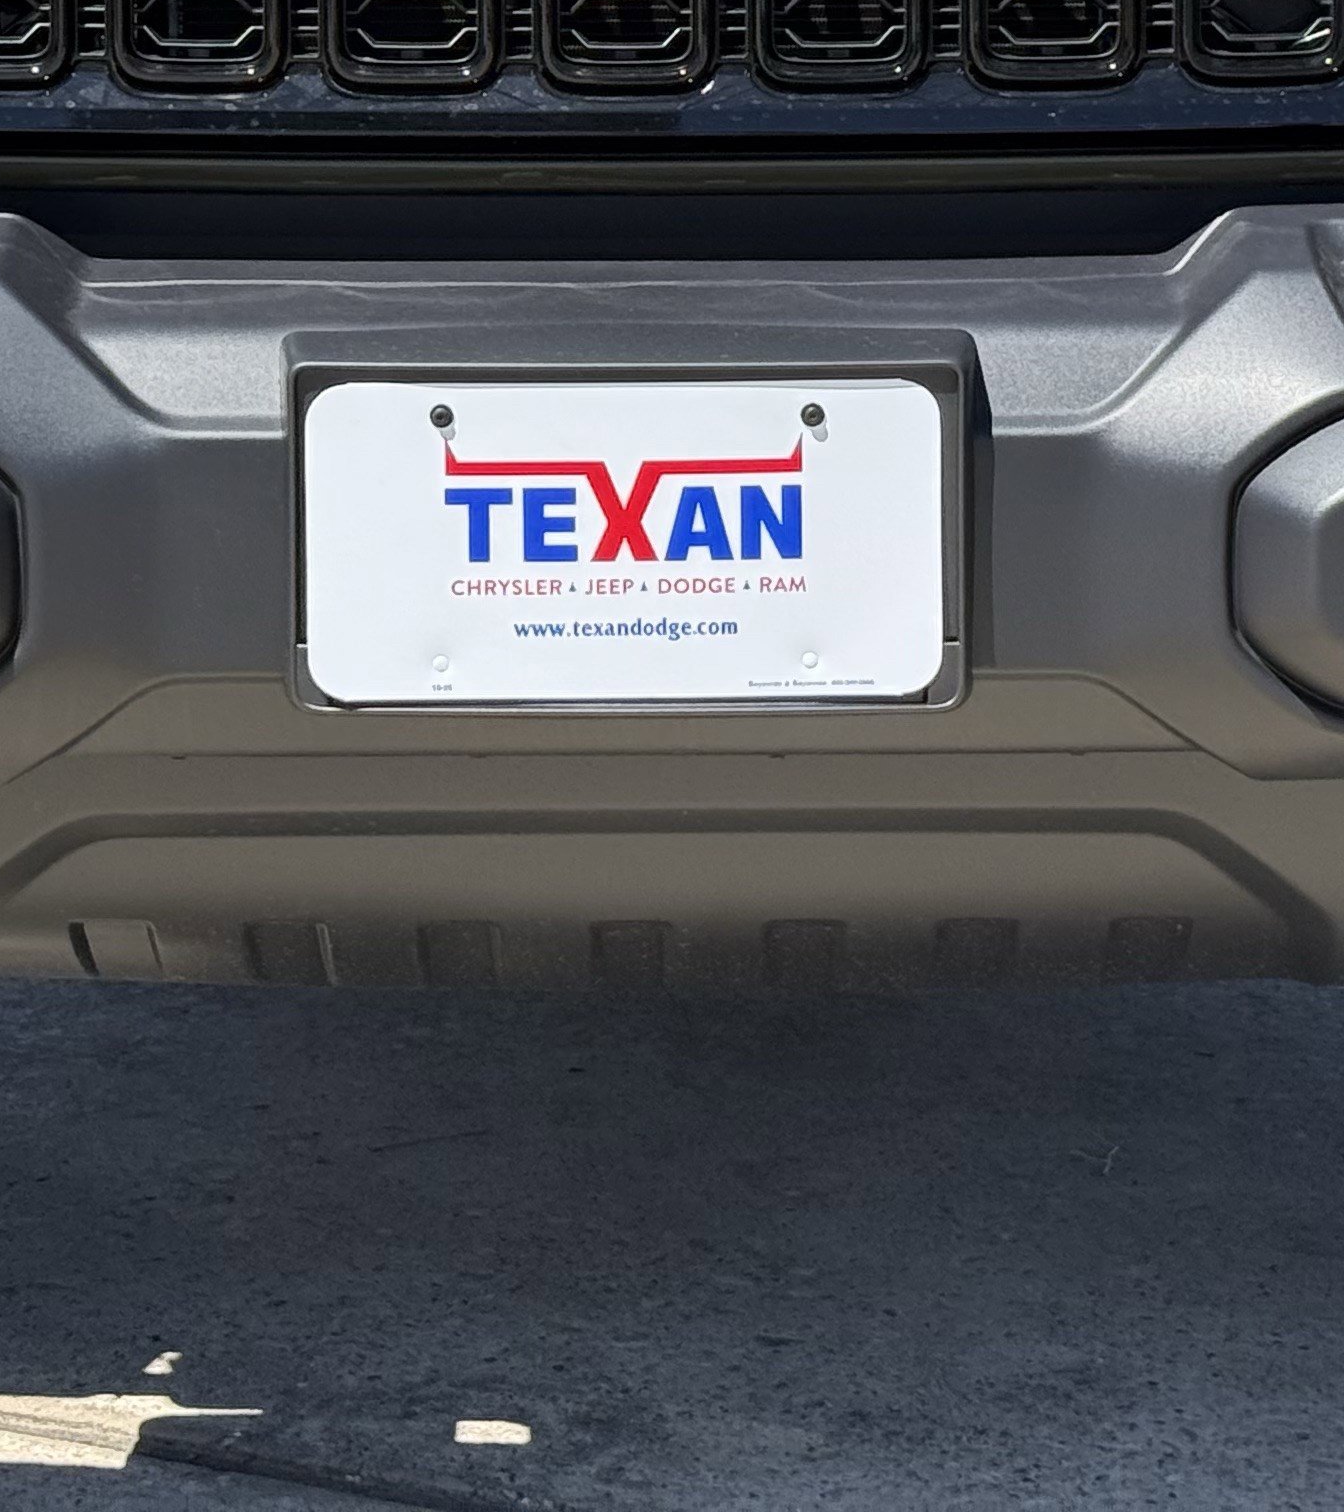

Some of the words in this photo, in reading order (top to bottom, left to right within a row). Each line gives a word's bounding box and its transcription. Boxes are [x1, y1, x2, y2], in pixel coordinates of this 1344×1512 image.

[444, 446, 803, 563] TEXAN
[450, 579, 563, 597] CHRYSLER
[584, 578, 635, 596] JEEP
[657, 576, 736, 595] DODGE
[759, 575, 807, 594] RAM
[513, 617, 739, 641] www.texandodge.com
